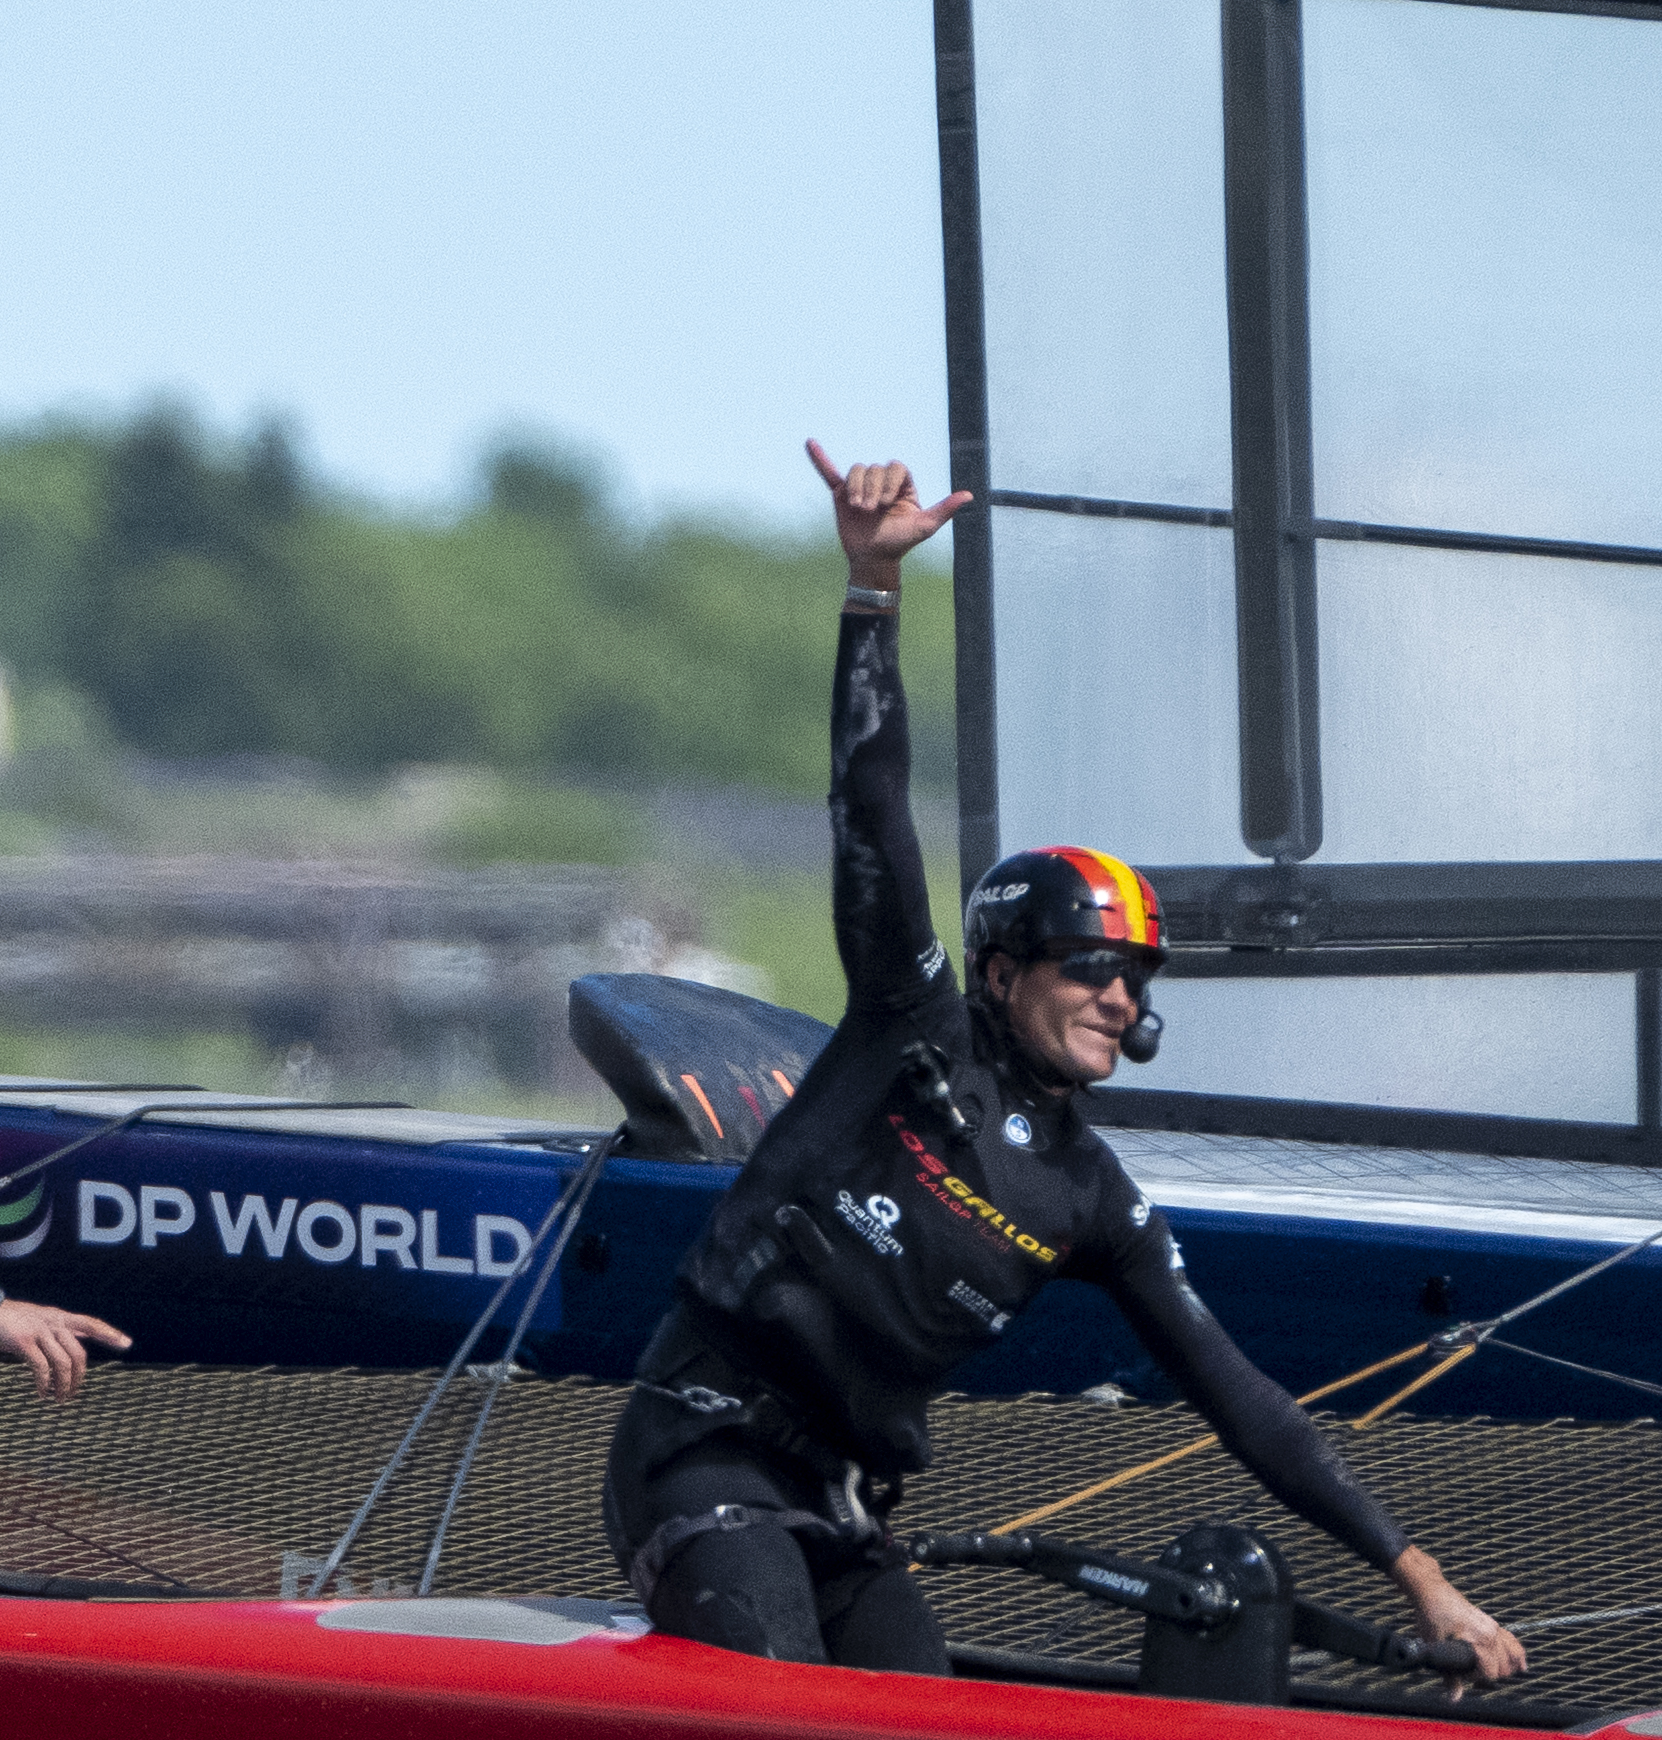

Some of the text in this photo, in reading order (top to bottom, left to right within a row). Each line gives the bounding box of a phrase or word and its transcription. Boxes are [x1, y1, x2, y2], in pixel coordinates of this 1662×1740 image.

[78, 1179, 533, 1278] DP WORLD
[837, 1189, 906, 1257] Quantum
